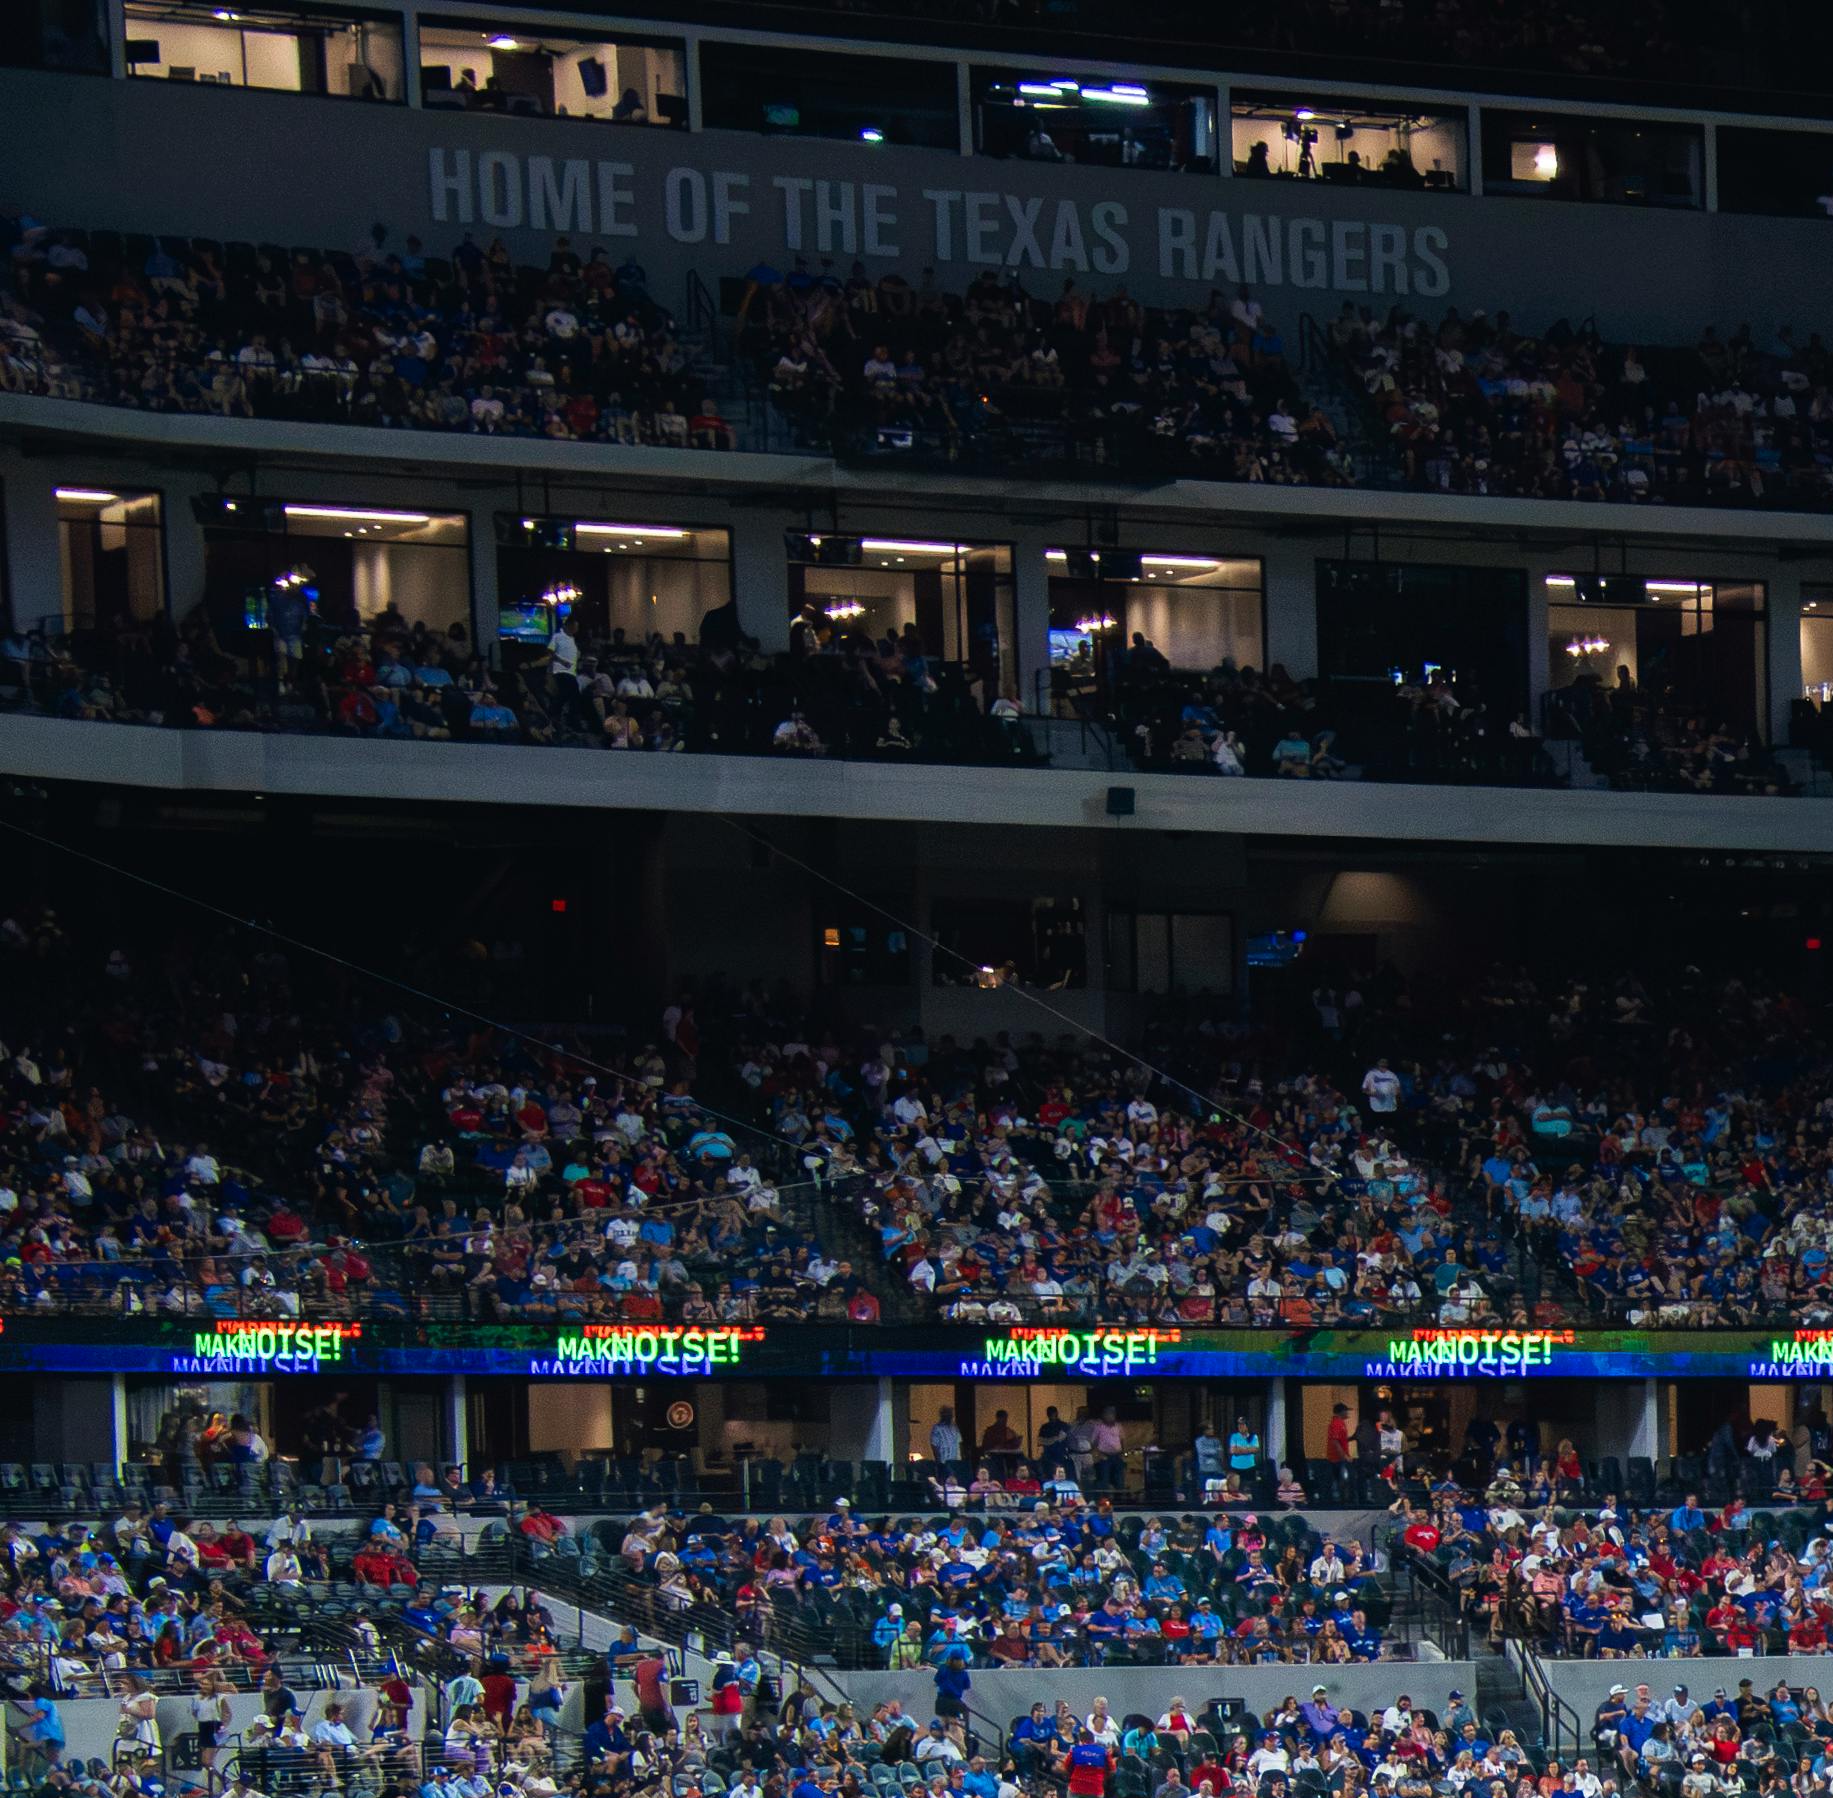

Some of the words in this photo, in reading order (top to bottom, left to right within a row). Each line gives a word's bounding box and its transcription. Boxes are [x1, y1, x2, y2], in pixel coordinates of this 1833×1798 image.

[429, 147, 638, 236] HOME
[666, 167, 750, 244] OF
[773, 176, 900, 257] THE
[922, 189, 1130, 274] TEXAS
[1158, 207, 1451, 296] RANGERS
[238, 1329, 341, 1360] NOISE!
[612, 1332, 739, 1363] NOISE!
[1037, 1334, 1157, 1364] NOISE!
[1439, 1336, 1551, 1364] NOISE!
